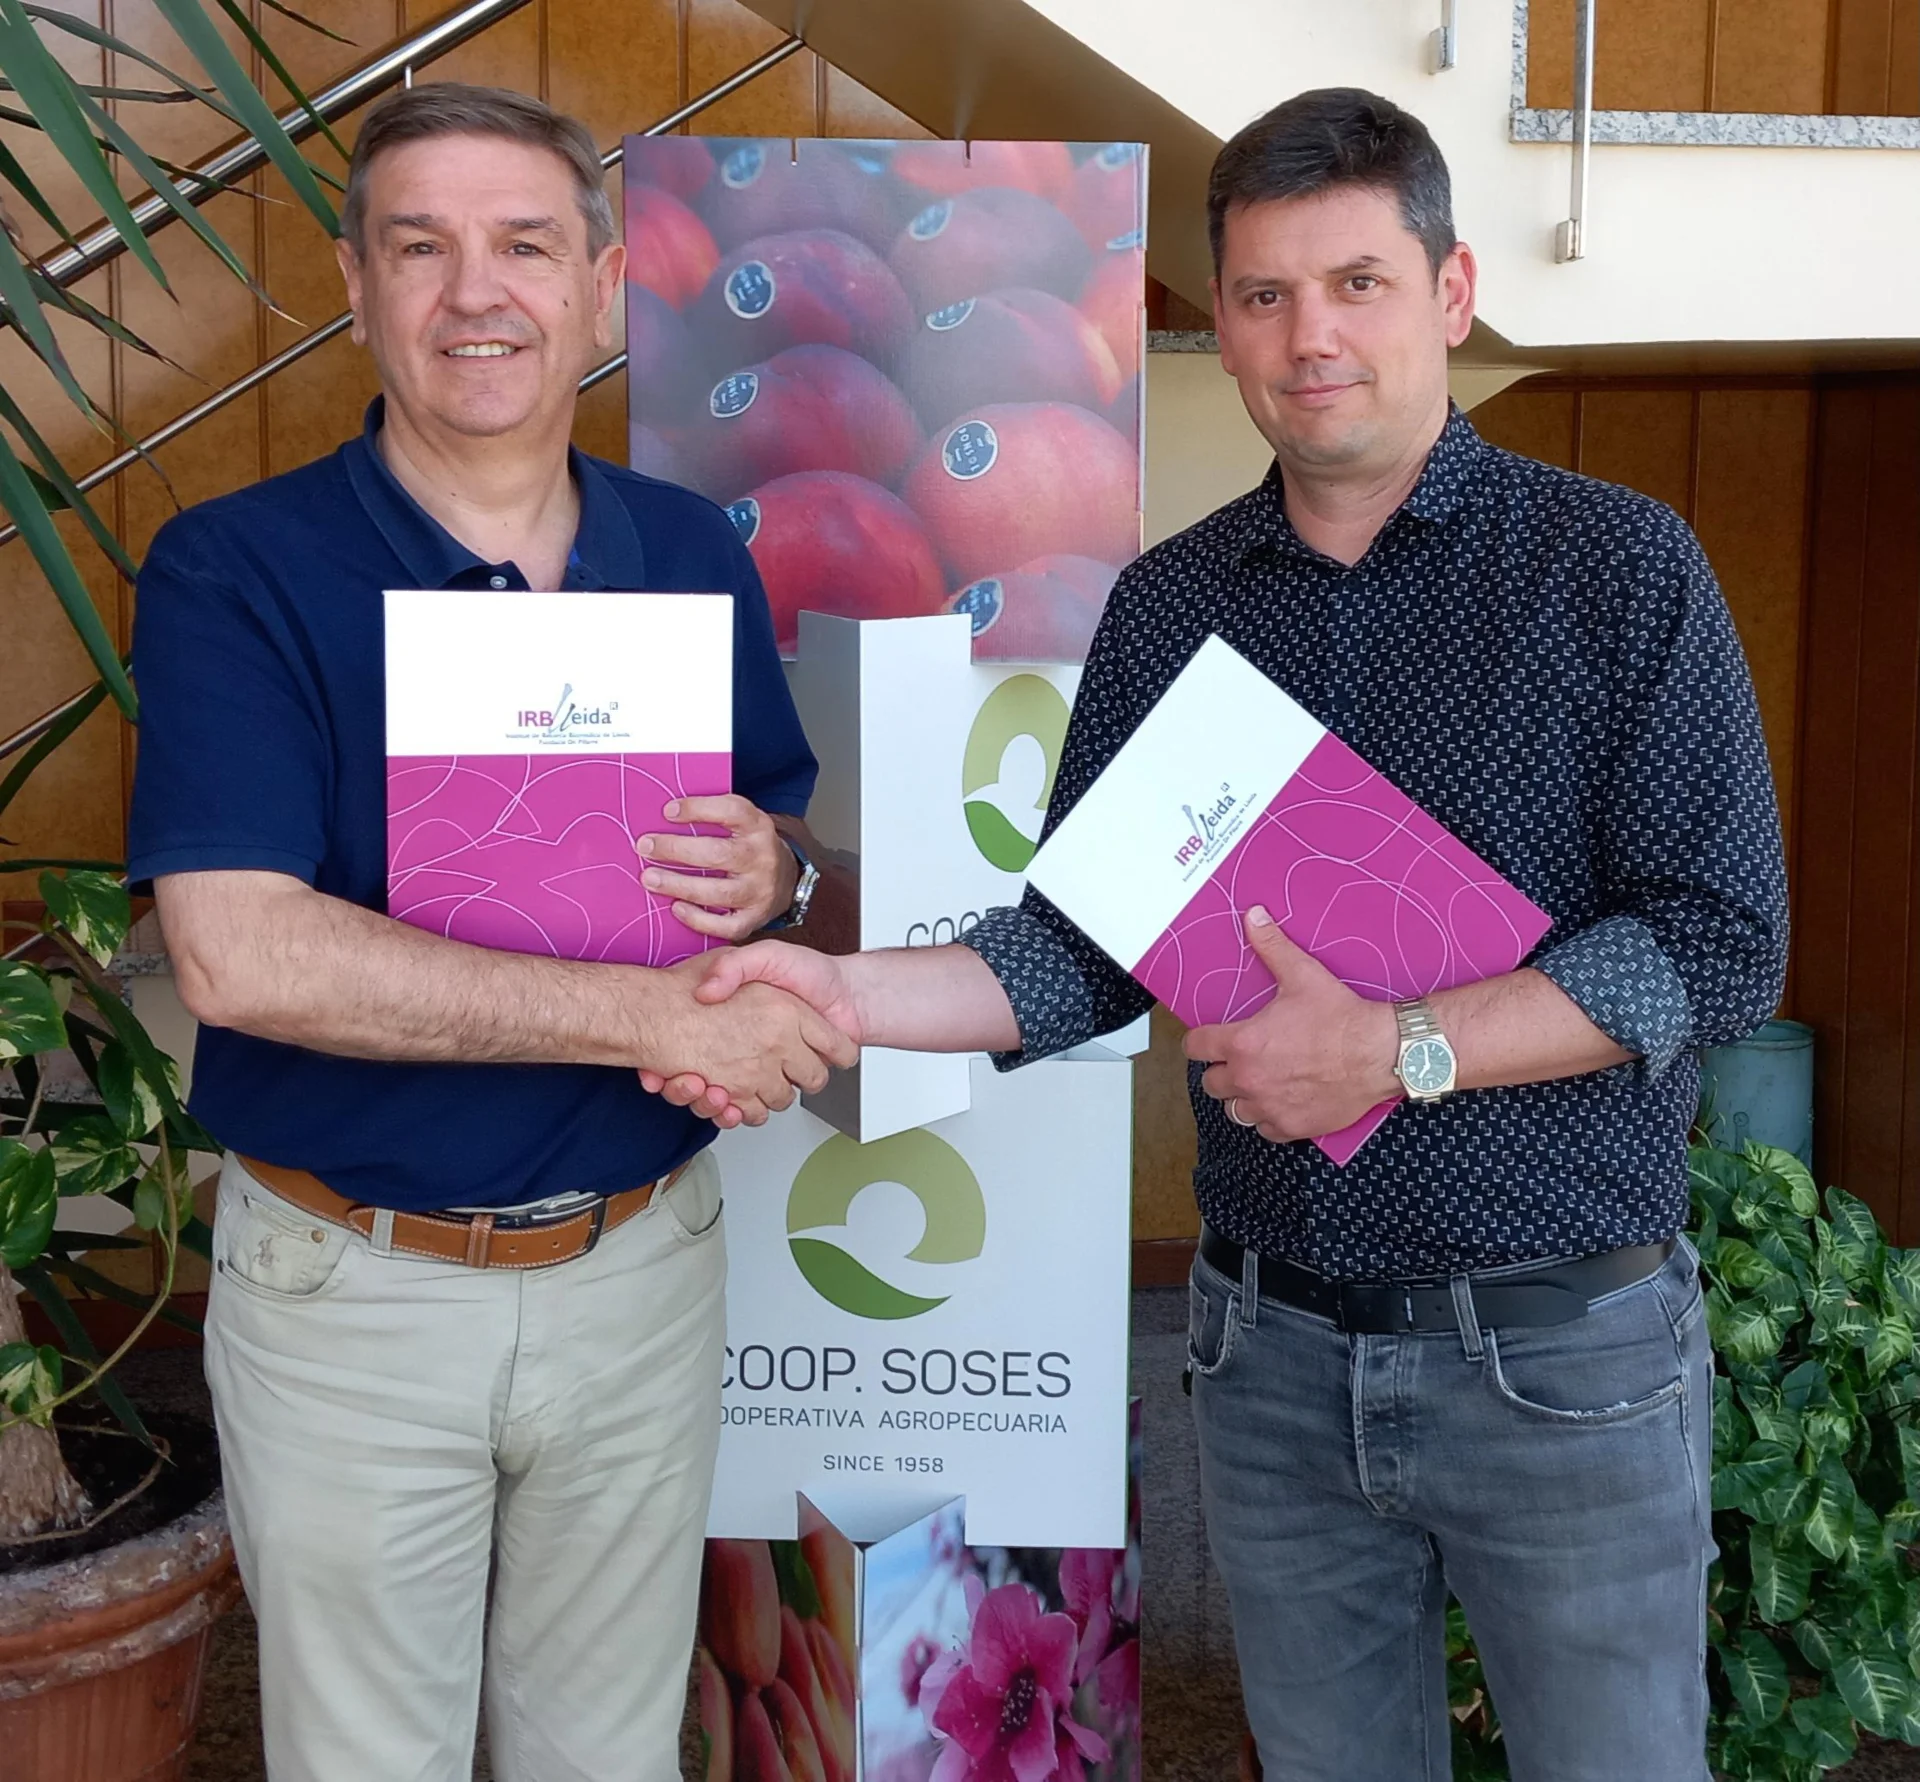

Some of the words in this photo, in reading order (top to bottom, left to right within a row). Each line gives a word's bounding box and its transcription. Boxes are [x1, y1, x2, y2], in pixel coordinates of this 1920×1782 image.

[881, 1347, 1071, 1398] SOSES
[878, 1410, 1067, 1434] AGROPECUARIA
[823, 1454, 884, 1472] SINCE
[894, 1456, 944, 1474] 1958
